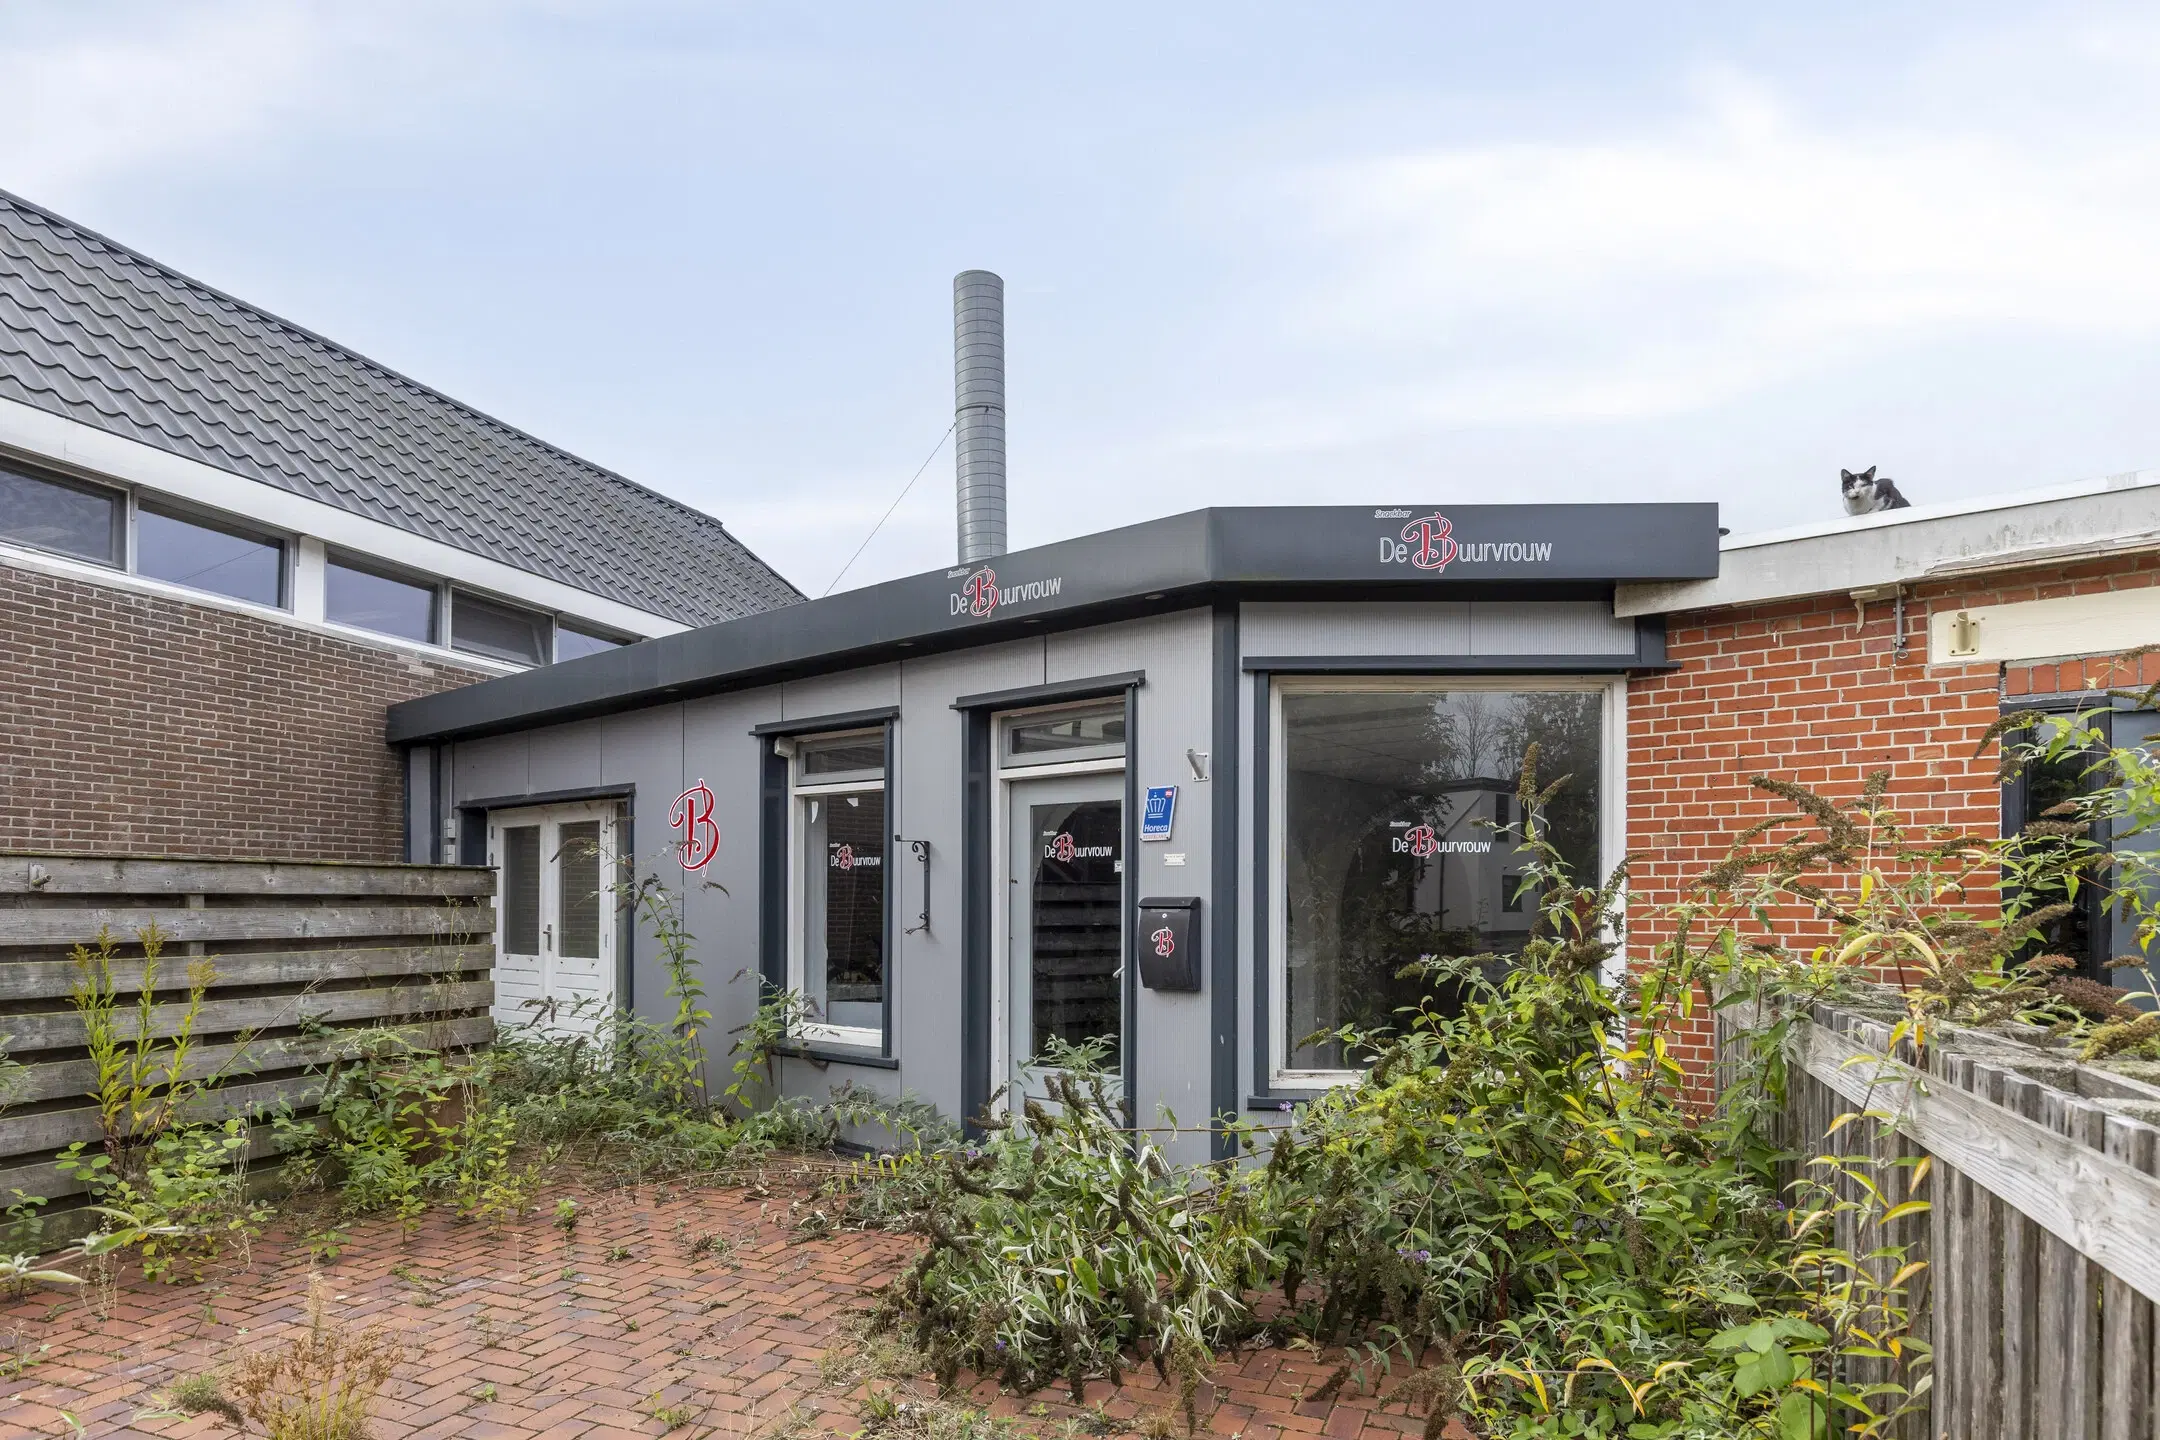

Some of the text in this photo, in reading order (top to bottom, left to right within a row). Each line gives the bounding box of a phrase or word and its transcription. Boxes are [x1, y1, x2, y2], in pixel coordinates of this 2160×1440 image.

[1374, 508, 1412, 519] Snackbar
[1379, 511, 1553, 574] De Buurvrouw
[950, 564, 1062, 618] De Buurvrouw
[668, 778, 720, 877] B
[1144, 824, 1168, 832] Horeca
[1392, 823, 1491, 859] De Buurvrouw
[830, 843, 881, 871] De Buurvrouw
[1044, 831, 1113, 863] De Buurvrouw
[1151, 926, 1175, 958] B
